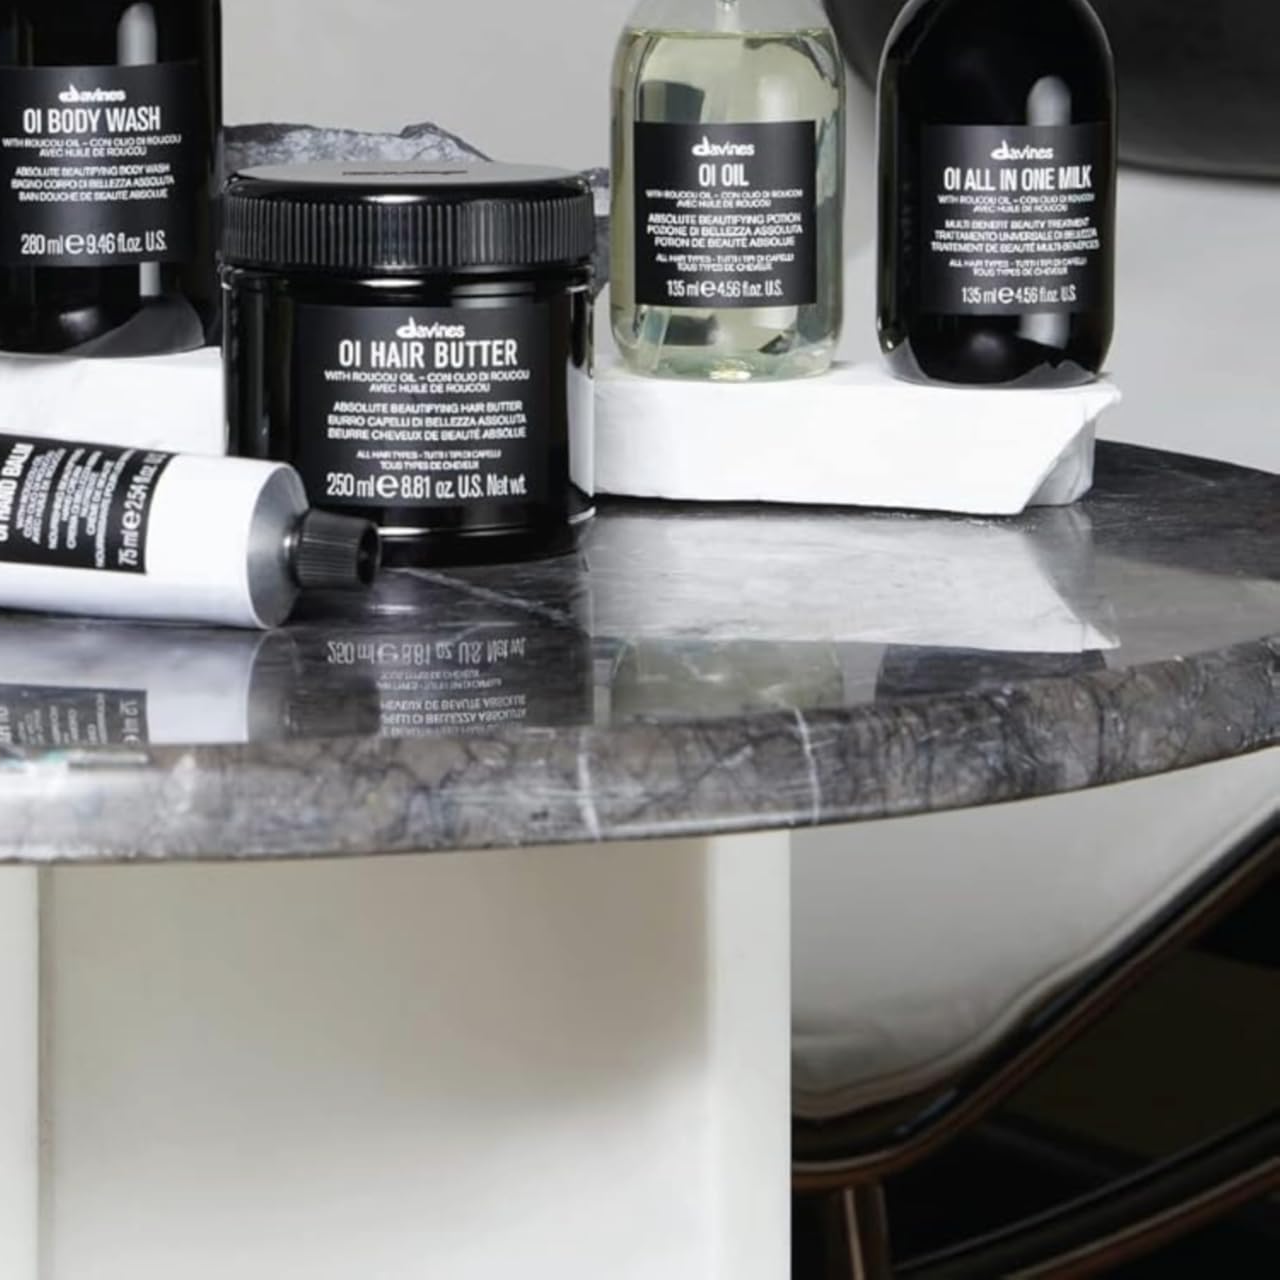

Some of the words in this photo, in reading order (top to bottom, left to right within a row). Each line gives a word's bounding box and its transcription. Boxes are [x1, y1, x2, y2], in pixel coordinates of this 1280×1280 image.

[58, 84, 126, 103] davines
[47, 108, 101, 134] BODY
[105, 105, 161, 133] WASH
[691, 135, 755, 156] davines
[991, 140, 1054, 160] davines
[721, 163, 750, 187] OIL
[963, 167, 996, 191] ALL
[999, 167, 1018, 191] IN
[1021, 167, 1055, 191] ONE
[1058, 164, 1092, 190] MILK
[47, 234, 64, 255] ml
[396, 316, 465, 339] davines
[370, 340, 425, 369] HAIR
[434, 338, 518, 369] BUTTER
[1, 443, 35, 477] BALM
[326, 472, 355, 496] 250
[356, 474, 375, 497] ml
[400, 474, 431, 498] 8.81
[486, 472, 508, 496] Net
[120, 529, 139, 548] ml
[118, 548, 138, 567] 75
